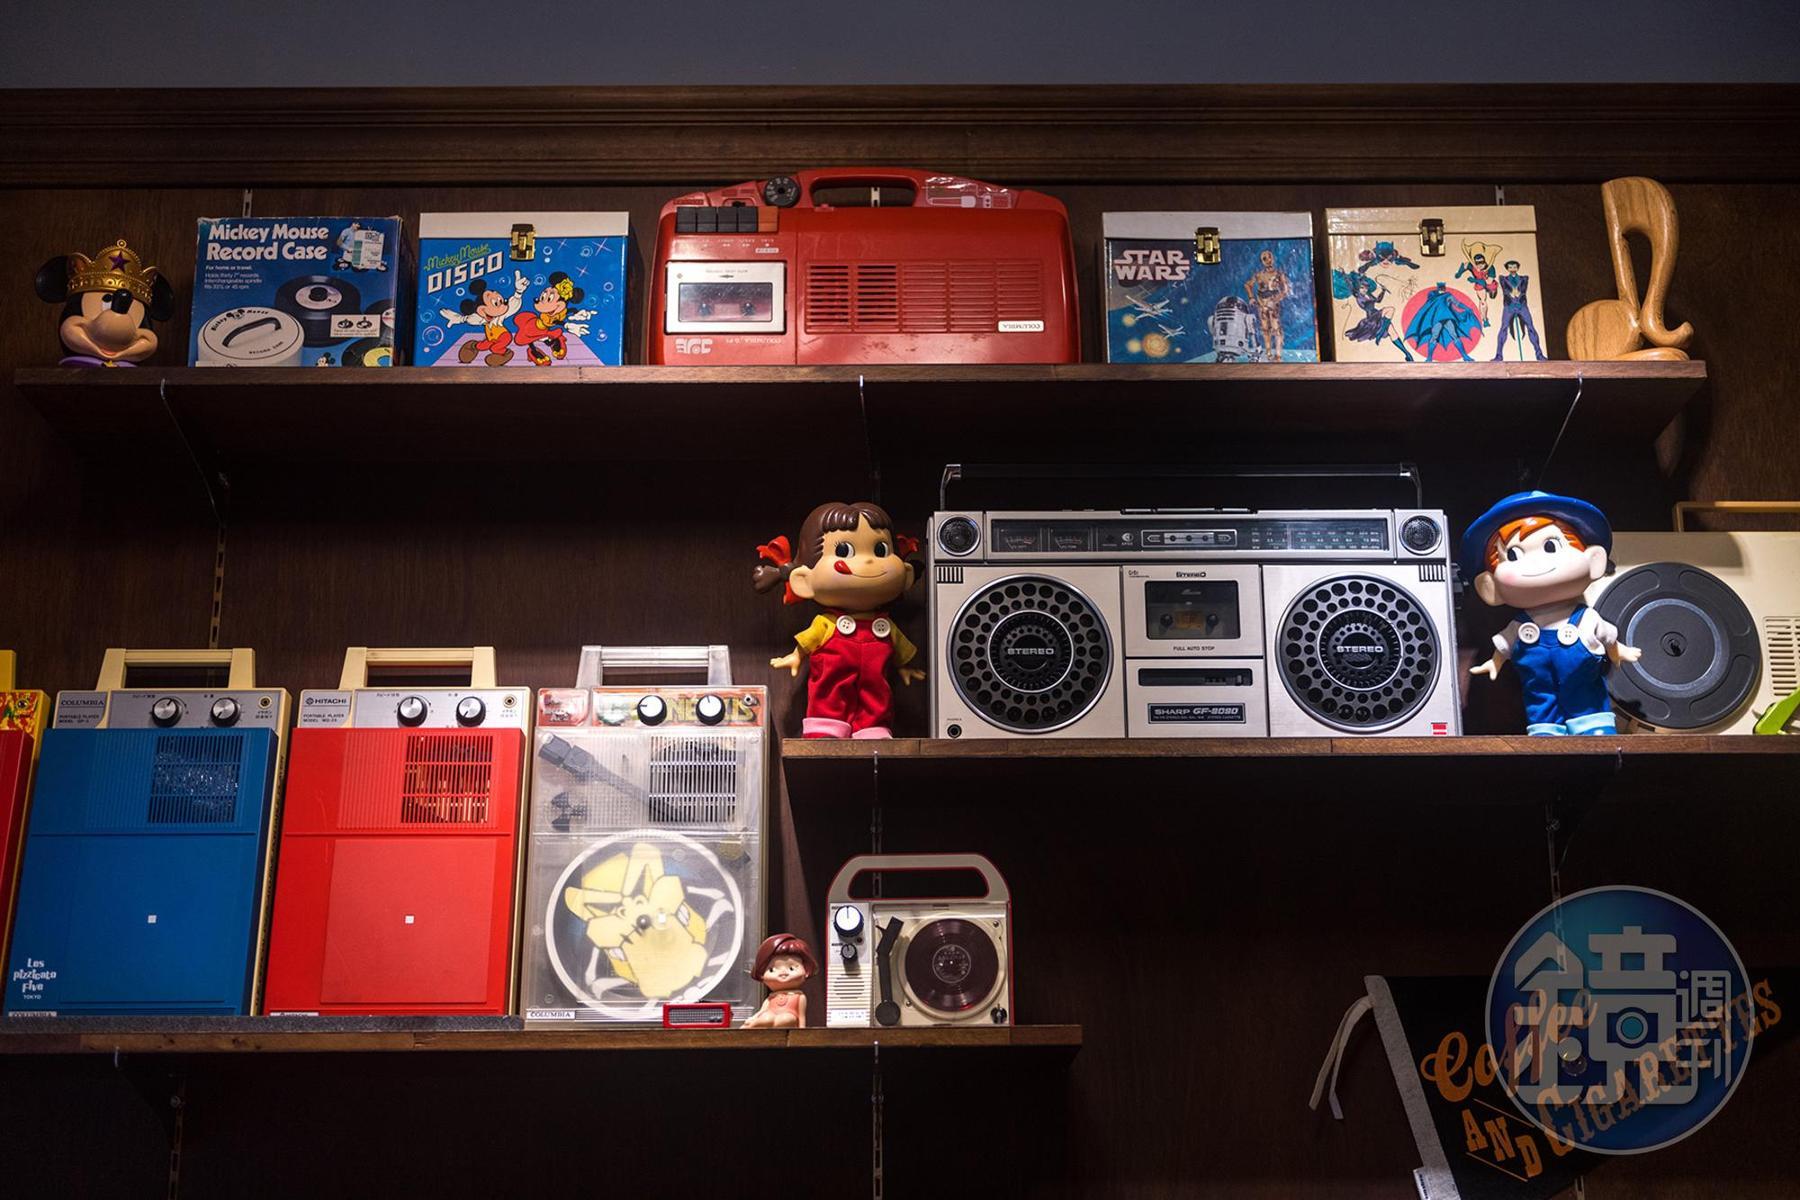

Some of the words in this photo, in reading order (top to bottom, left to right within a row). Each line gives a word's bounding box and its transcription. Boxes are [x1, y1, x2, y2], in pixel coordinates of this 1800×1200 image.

[208, 224, 270, 243] Mickey
[272, 223, 329, 240] Mouse
[206, 242, 278, 261] Record
[282, 241, 328, 260] Case
[424, 253, 460, 272] Mickey
[458, 243, 492, 263] Mouse
[1114, 250, 1190, 265] STAR
[427, 251, 503, 294] DISCO
[1114, 265, 1190, 280] WARS
[27, 957, 45, 968] Les
[12, 968, 57, 982] pizzicato
[1461, 1108, 1543, 1180] AND
